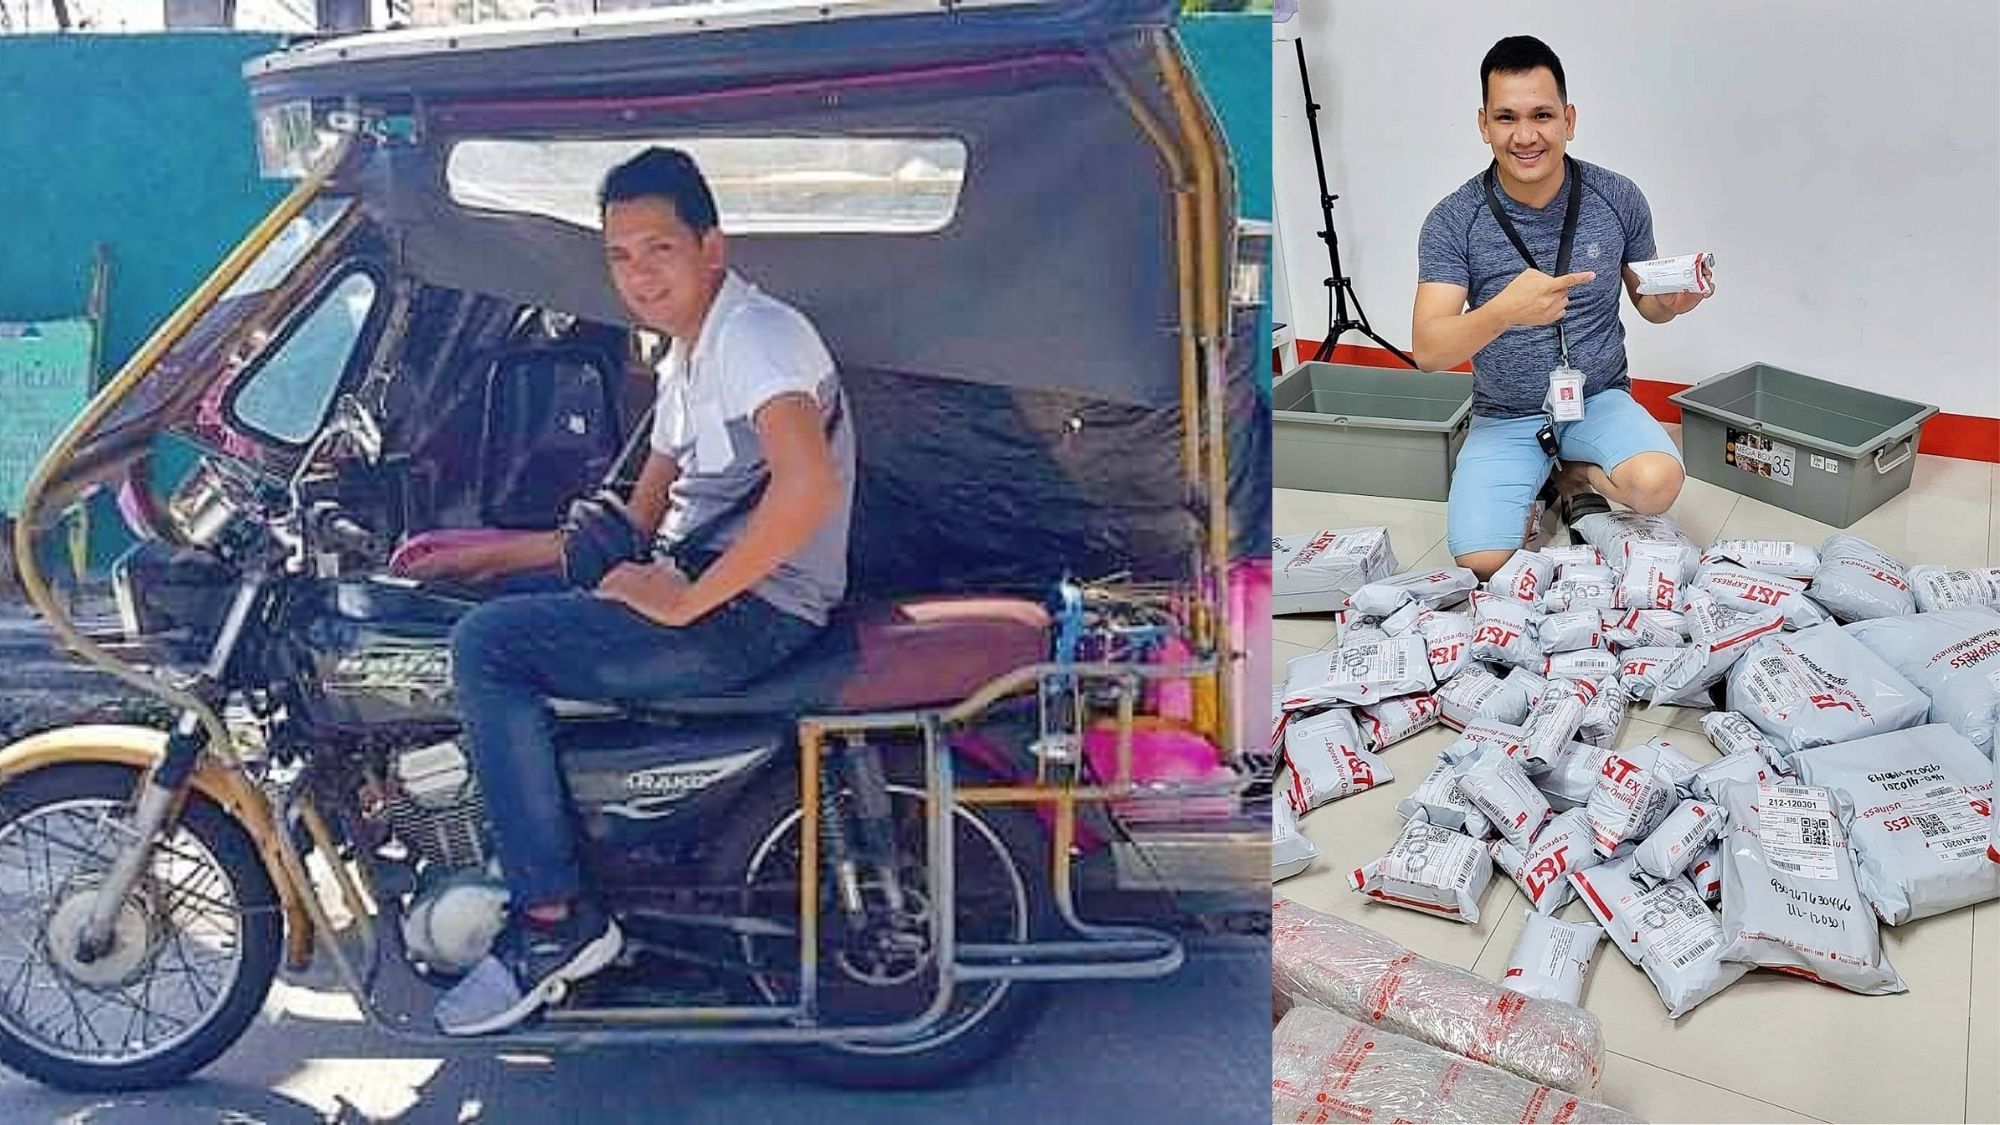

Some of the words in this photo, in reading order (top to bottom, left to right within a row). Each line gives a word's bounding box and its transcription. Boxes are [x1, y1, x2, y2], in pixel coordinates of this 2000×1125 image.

[1772, 455, 1791, 477] 35
[1518, 568, 1538, 604] J&T
[1656, 572, 1674, 610] J&T
[1711, 577, 1748, 590] EXPRESS
[1737, 583, 1790, 606] J&T
[1326, 738, 1340, 768] Express
[1336, 766, 1347, 784] Your
[1340, 745, 1374, 789] J&T
[1769, 799, 1818, 810] 212-120301
[1862, 800, 1902, 818] usiness
[1544, 832, 1571, 850] Express
[1524, 846, 1544, 866] Your
[1525, 845, 1568, 902] J&T
